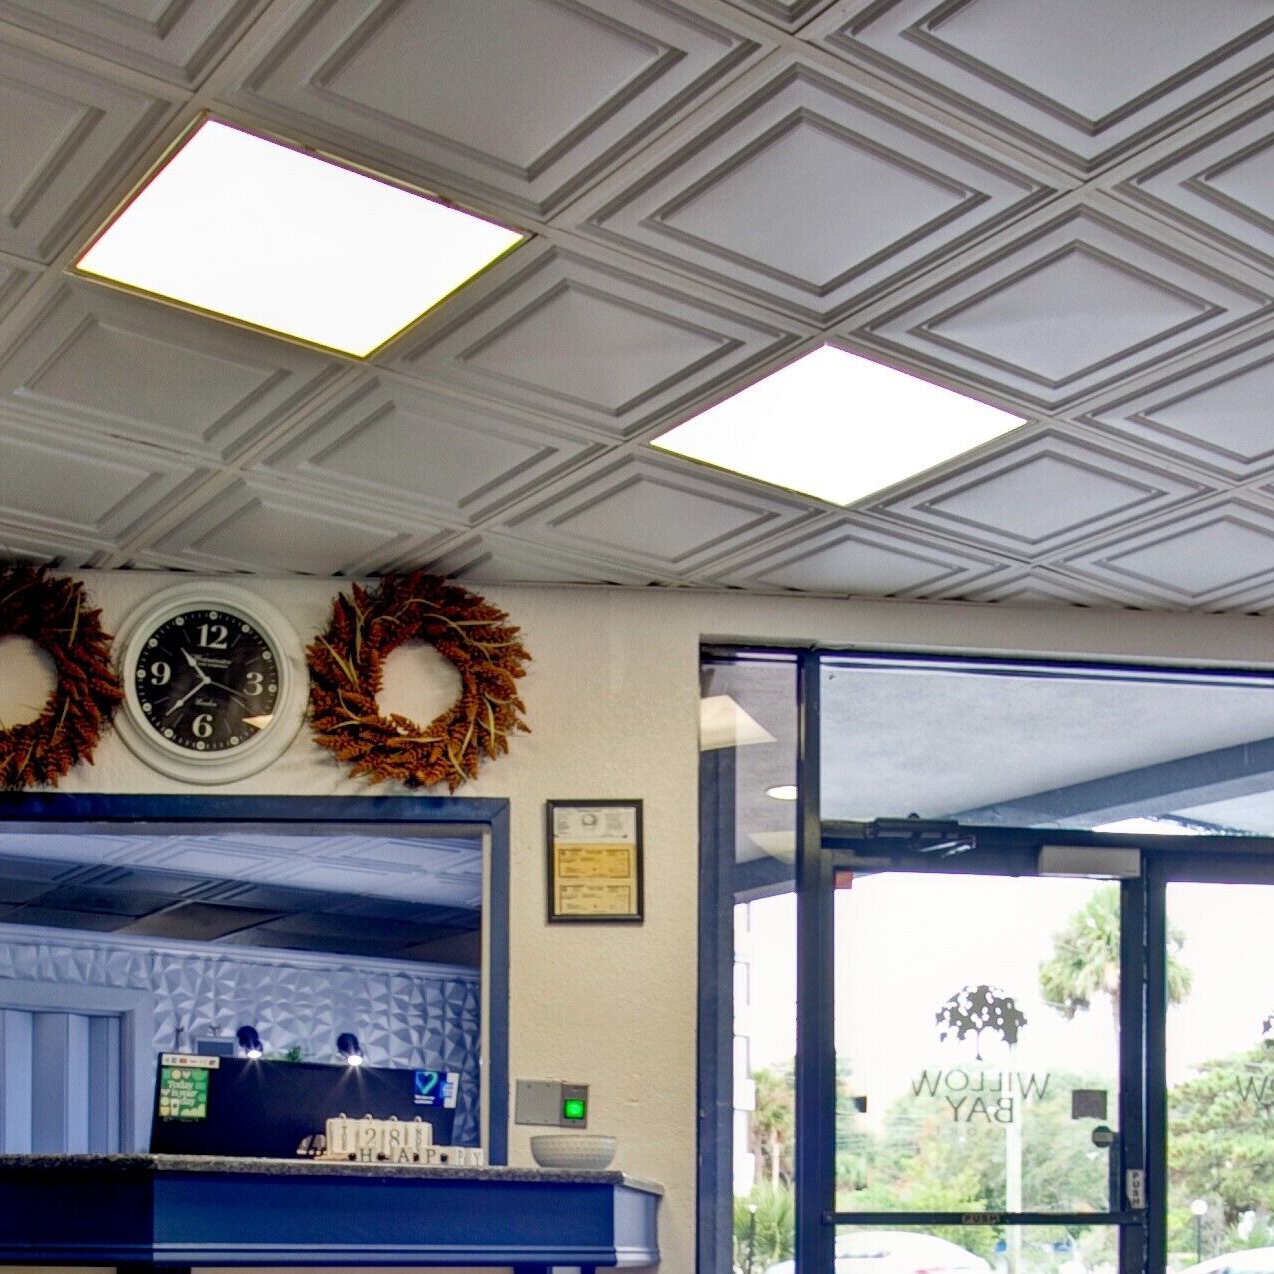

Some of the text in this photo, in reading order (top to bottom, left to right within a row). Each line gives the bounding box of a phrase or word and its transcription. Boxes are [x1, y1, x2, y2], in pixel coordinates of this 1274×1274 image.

[197, 624, 228, 649] 12
[151, 661, 171, 685] 9
[243, 672, 263, 696] 3
[192, 714, 212, 738] 6
[365, 1128, 401, 1147] 28
